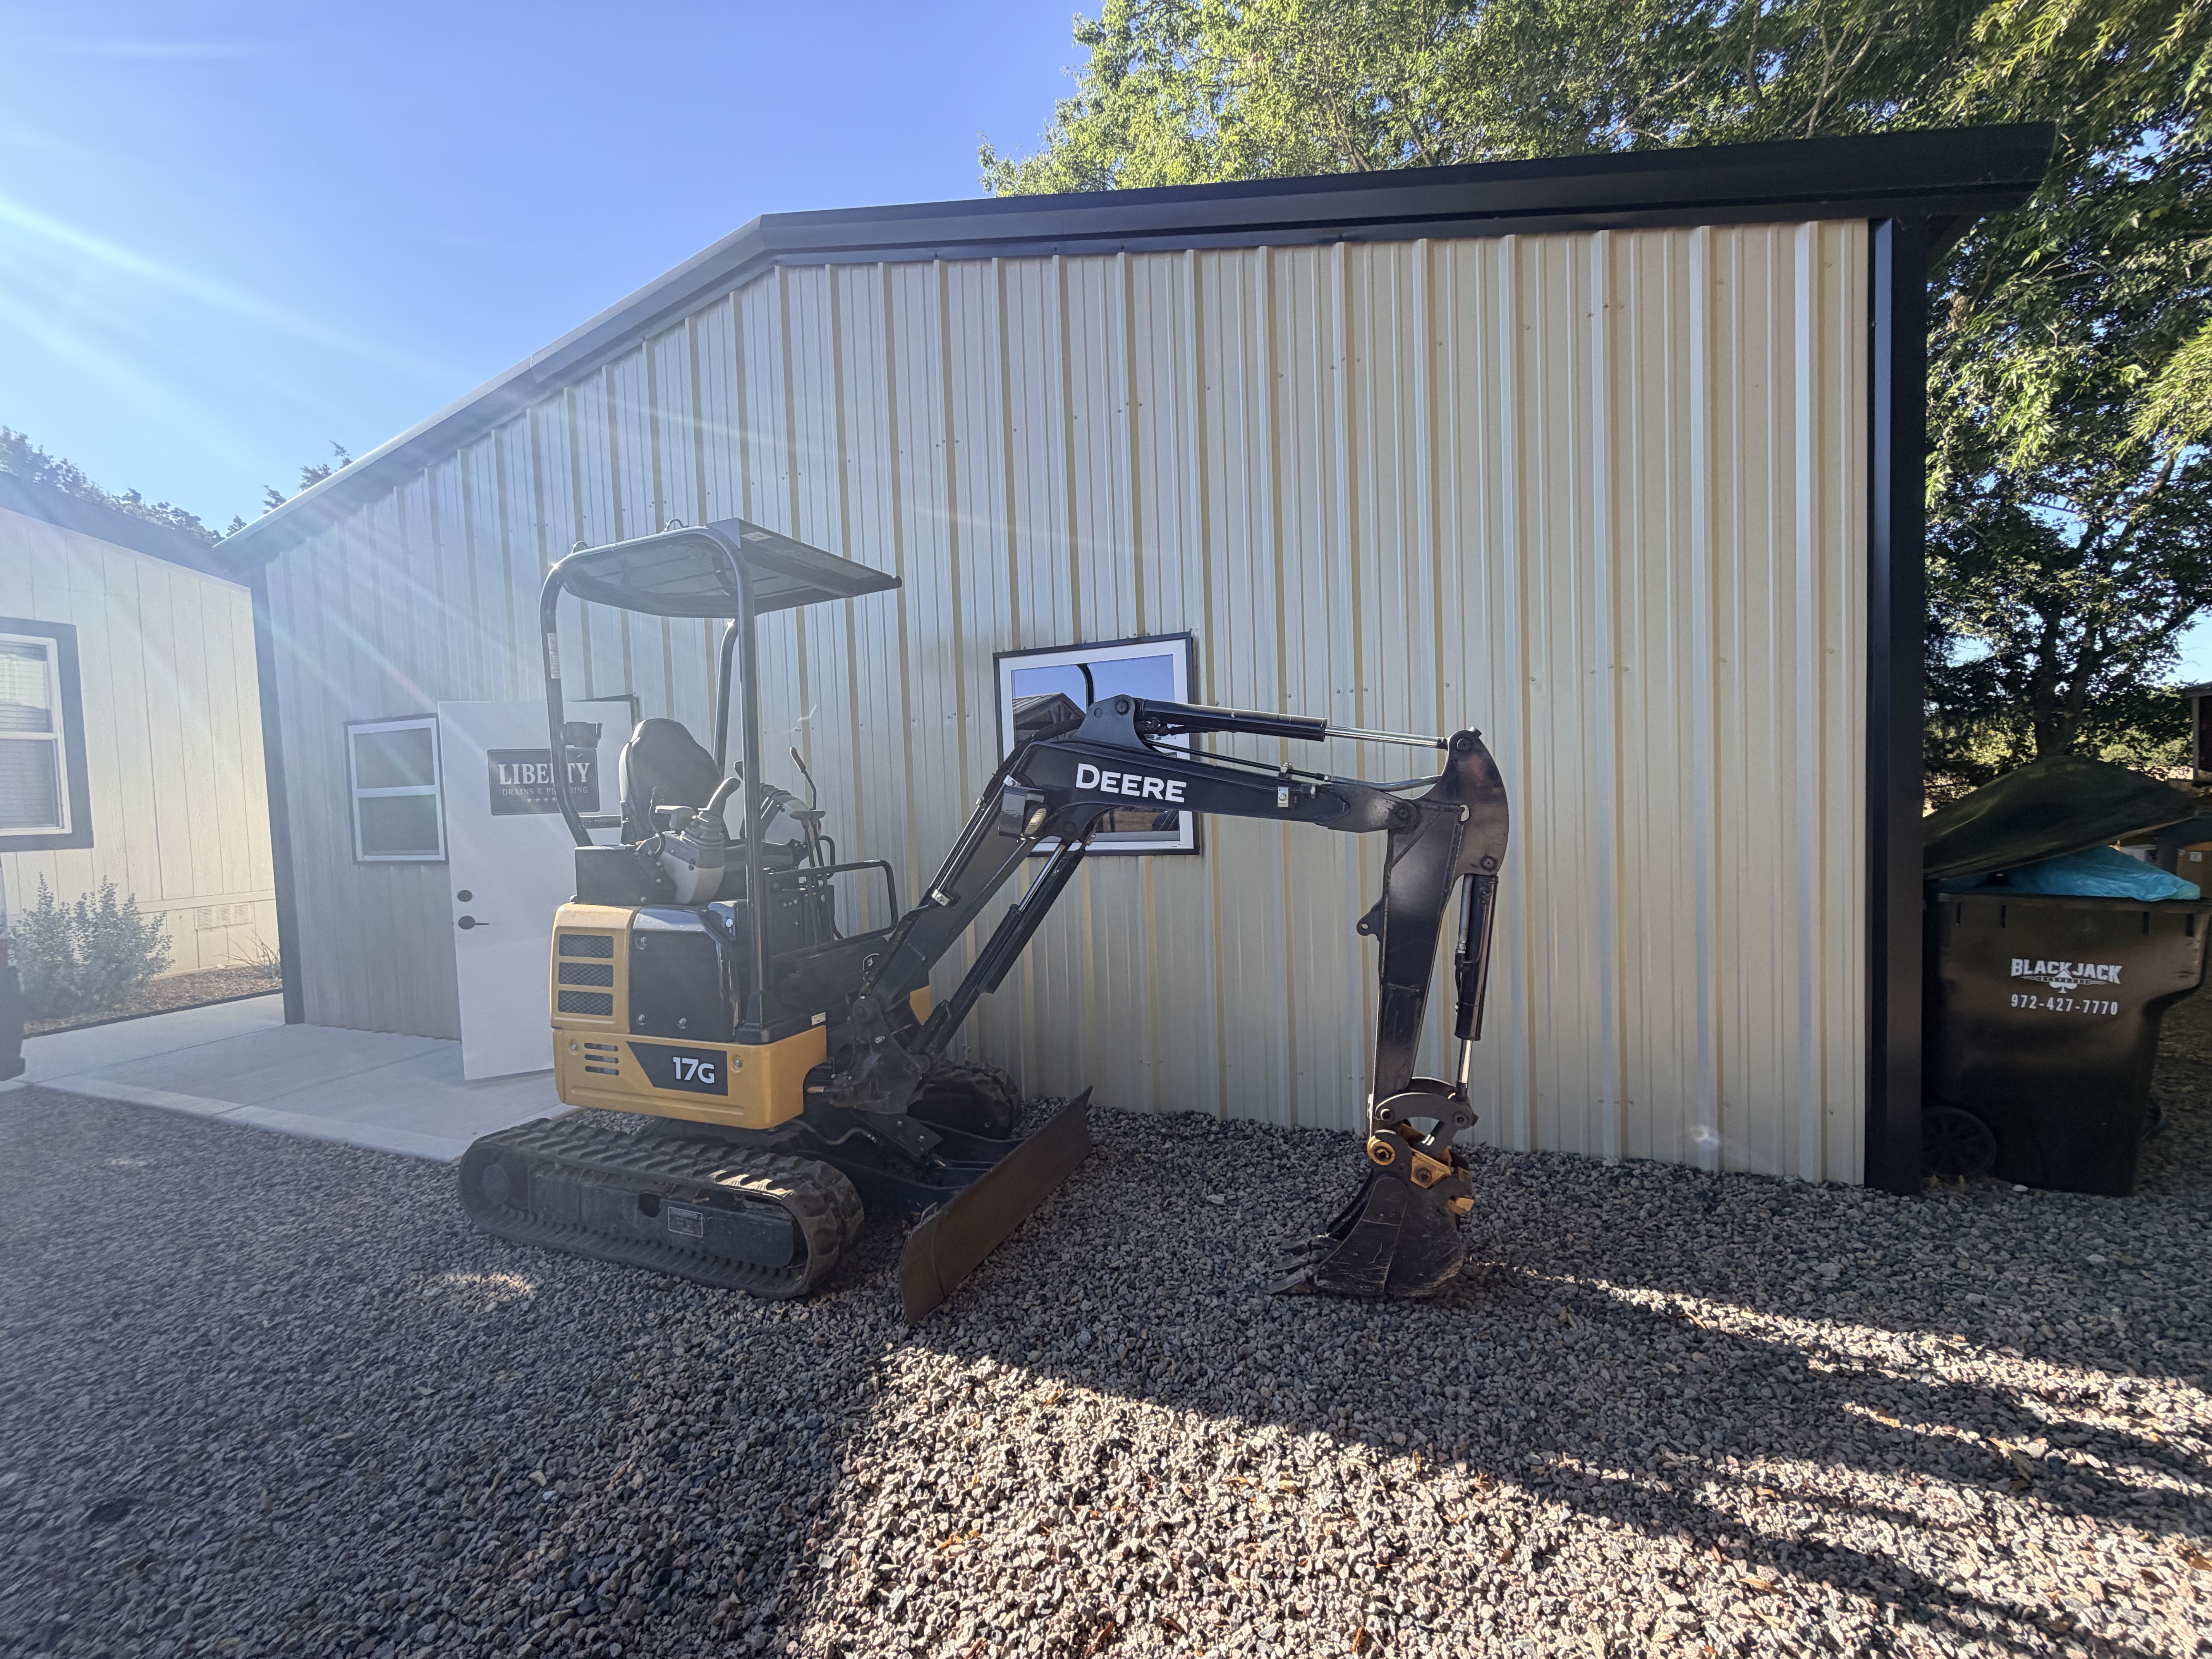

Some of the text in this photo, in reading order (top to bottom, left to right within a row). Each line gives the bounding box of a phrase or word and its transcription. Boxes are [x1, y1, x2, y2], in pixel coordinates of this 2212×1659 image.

[498, 763, 590, 785] LIBETY
[1076, 763, 1186, 803] DEERE
[546, 787, 588, 795] PLBING
[2011, 994, 2118, 1015] 972-427-7770
[673, 1057, 714, 1084] 17G
